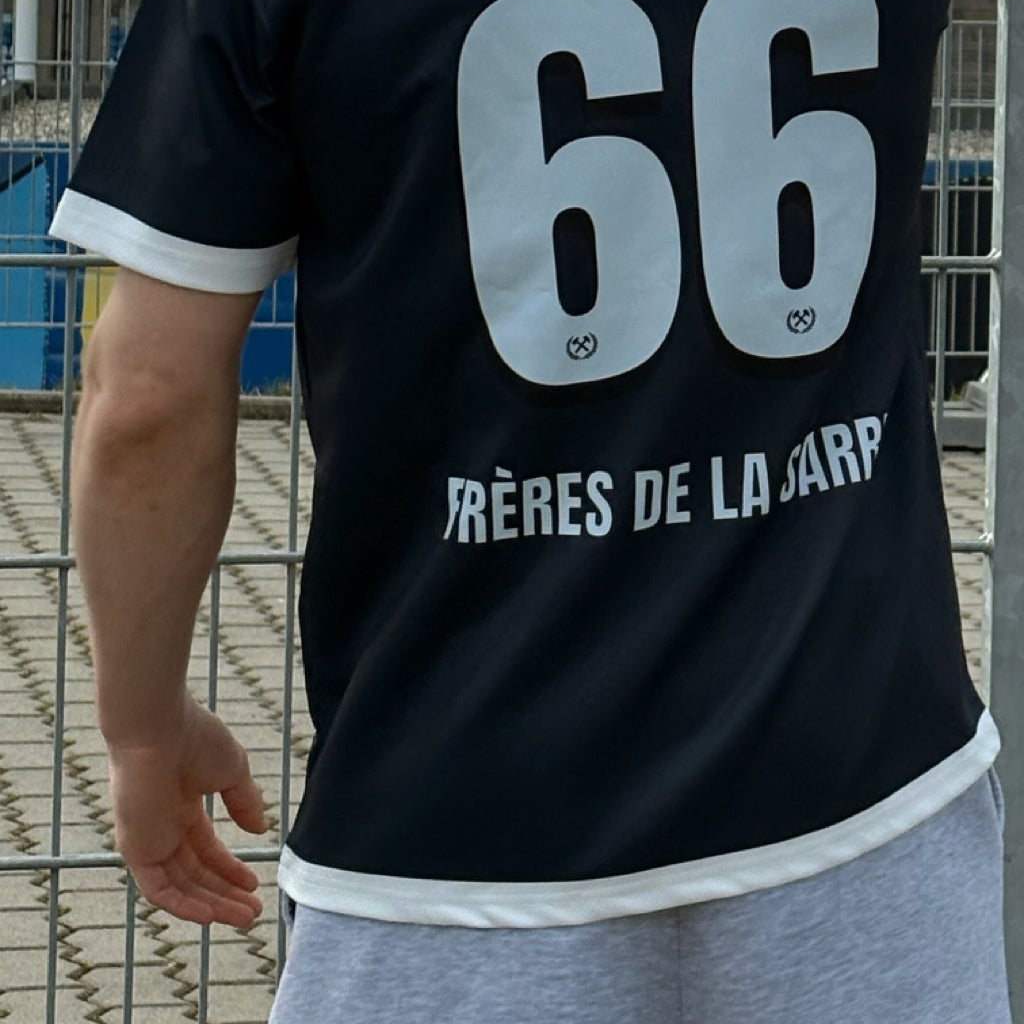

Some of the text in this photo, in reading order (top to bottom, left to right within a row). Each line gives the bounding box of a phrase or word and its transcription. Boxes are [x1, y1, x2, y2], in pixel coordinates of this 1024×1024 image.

[634, 462, 691, 531] DE
[711, 453, 769, 520] LA
[780, 413, 888, 503] SARR
